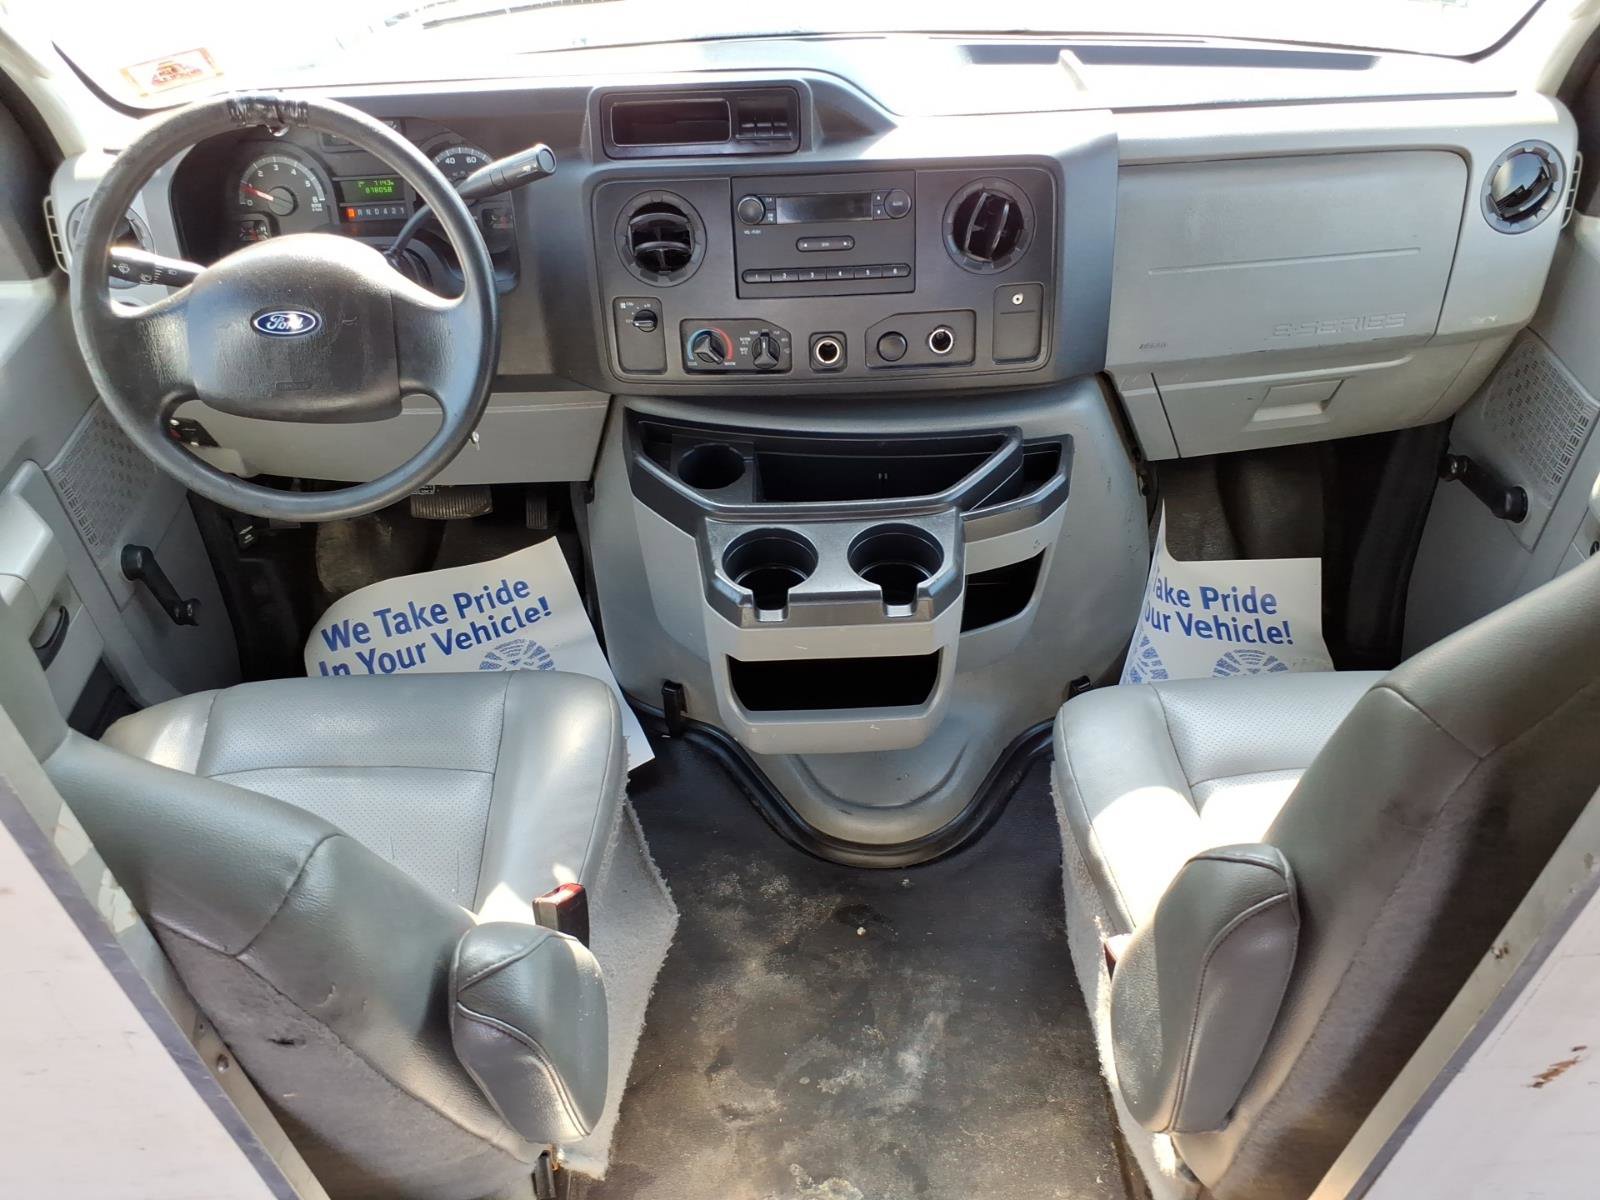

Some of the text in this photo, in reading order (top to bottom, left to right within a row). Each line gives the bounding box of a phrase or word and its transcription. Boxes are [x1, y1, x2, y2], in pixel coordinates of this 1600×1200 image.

[466, 156, 477, 164] 60
[1153, 577, 1277, 615] ake Pride
[320, 579, 530, 652] We Take Pride
[1175, 611, 1294, 645] Vehicle!
[318, 660, 351, 676] In
[355, 641, 427, 675] Your
[430, 595, 552, 656] Vehicle!
